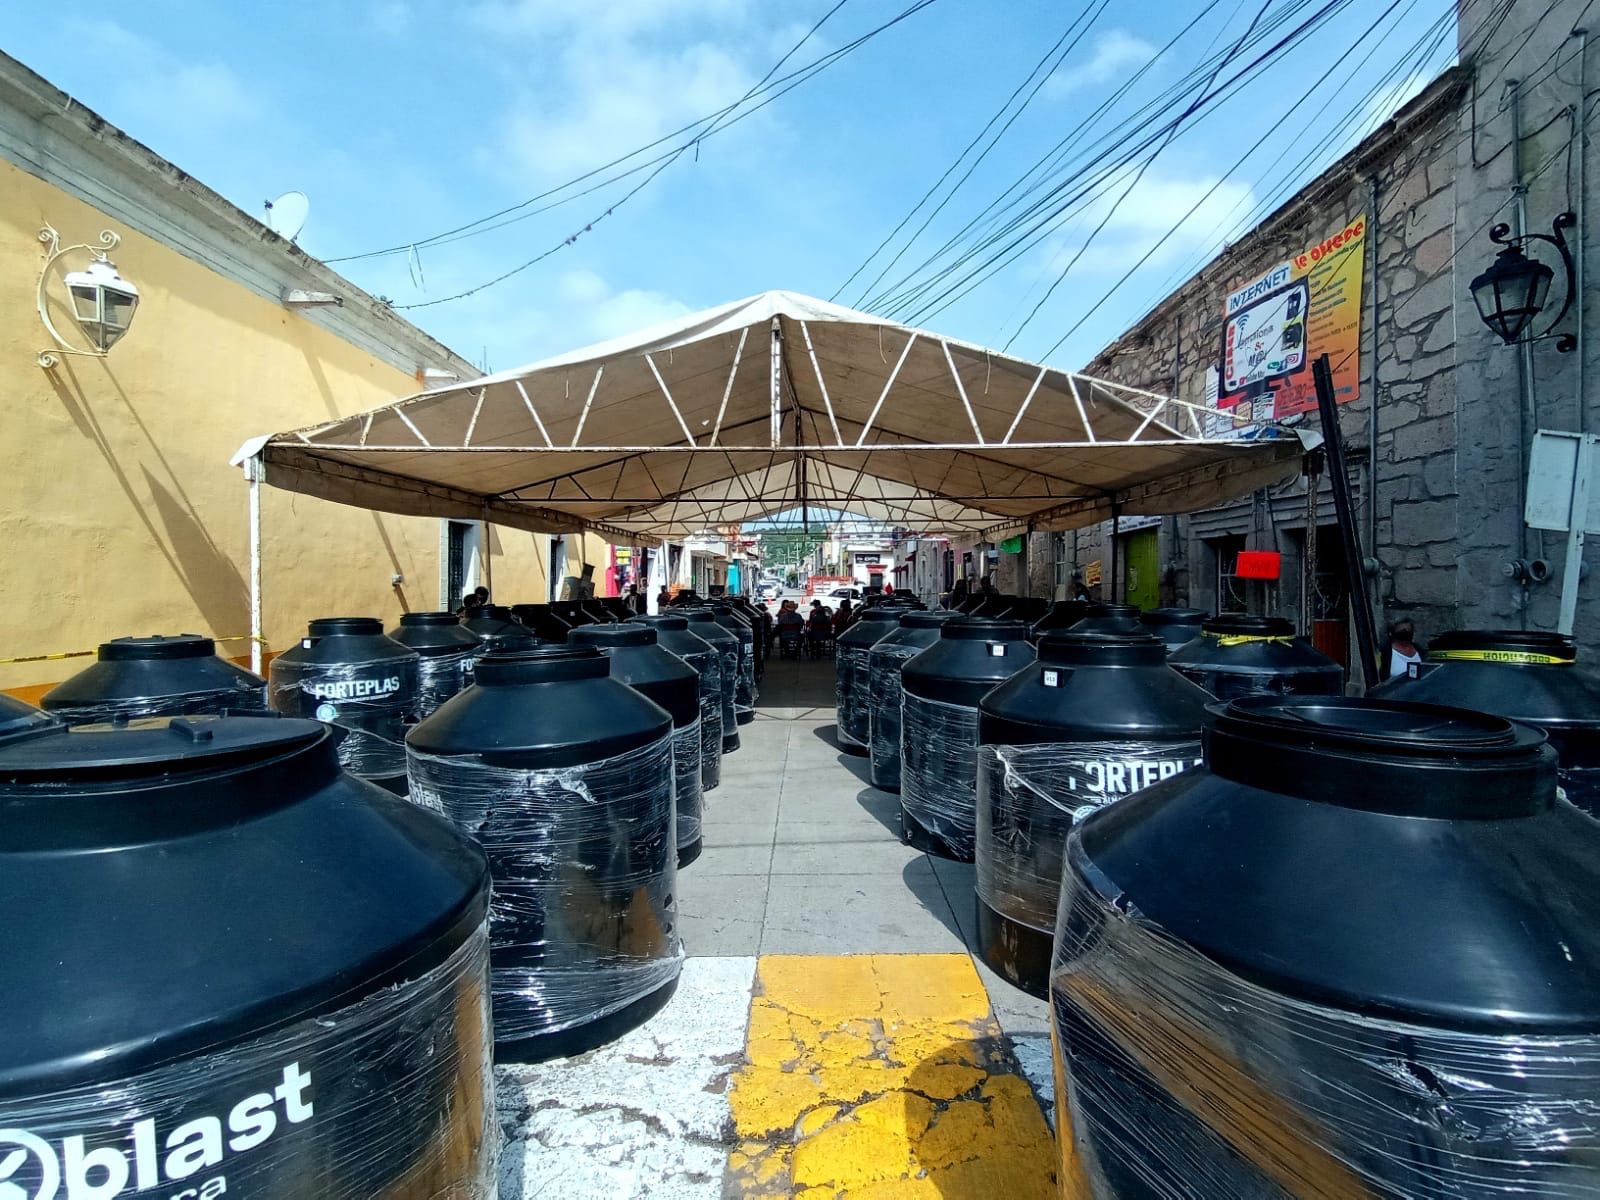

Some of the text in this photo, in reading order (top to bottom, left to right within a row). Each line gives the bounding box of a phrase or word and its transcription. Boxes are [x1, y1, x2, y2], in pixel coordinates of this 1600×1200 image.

[1229, 267, 1289, 311] INTERNET
[460, 658, 478, 672] FO
[315, 676, 400, 699] FORTEPLAS
[1069, 758, 1203, 792] ORTEP
[62, 1061, 314, 1200] blast
